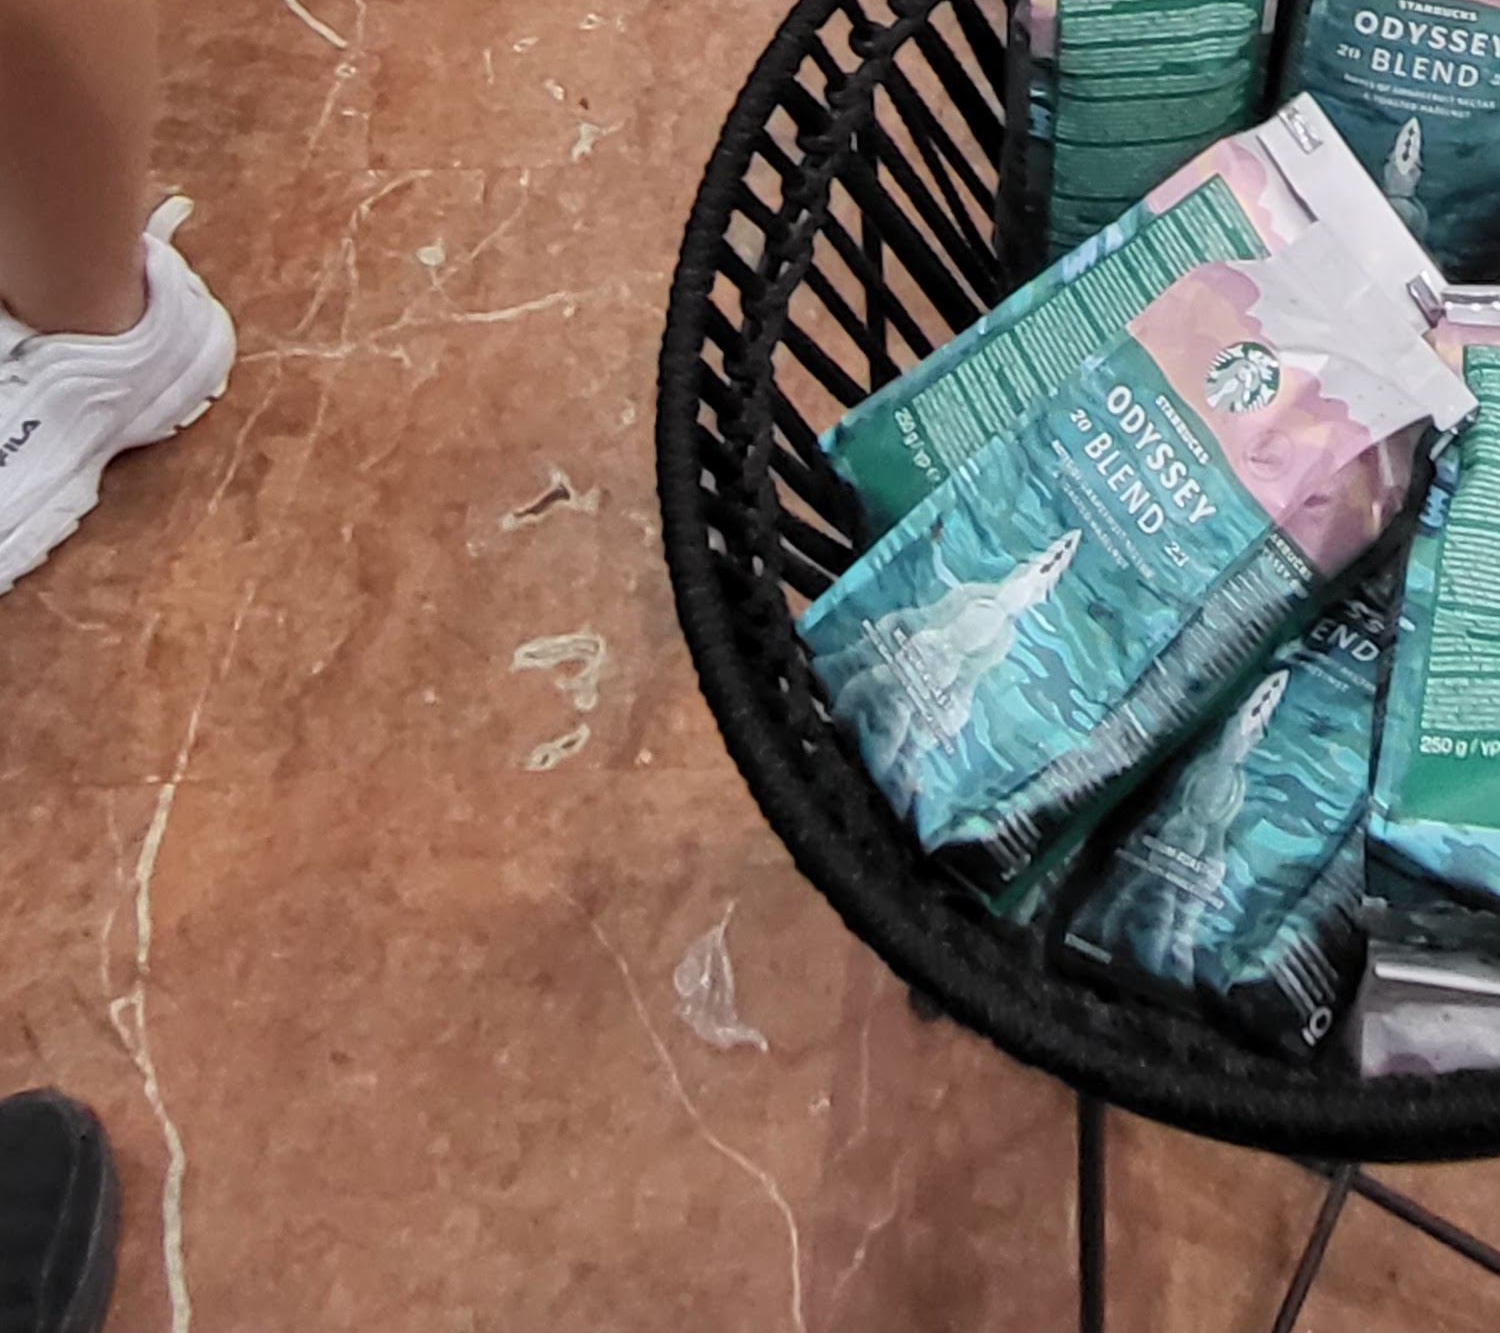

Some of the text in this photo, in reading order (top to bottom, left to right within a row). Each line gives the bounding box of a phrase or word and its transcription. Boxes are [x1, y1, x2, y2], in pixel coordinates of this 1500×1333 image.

[1336, 43, 1361, 60] 20
[1371, 47, 1479, 88] BLEND
[0, 419, 42, 467] FILA
[1106, 385, 1217, 524] ODYSSEY
[1069, 408, 1093, 432] 20
[1084, 432, 1165, 534] BLEND
[1311, 616, 1381, 662] END
[1419, 735, 1452, 755] 250
[1455, 740, 1468, 759] g
